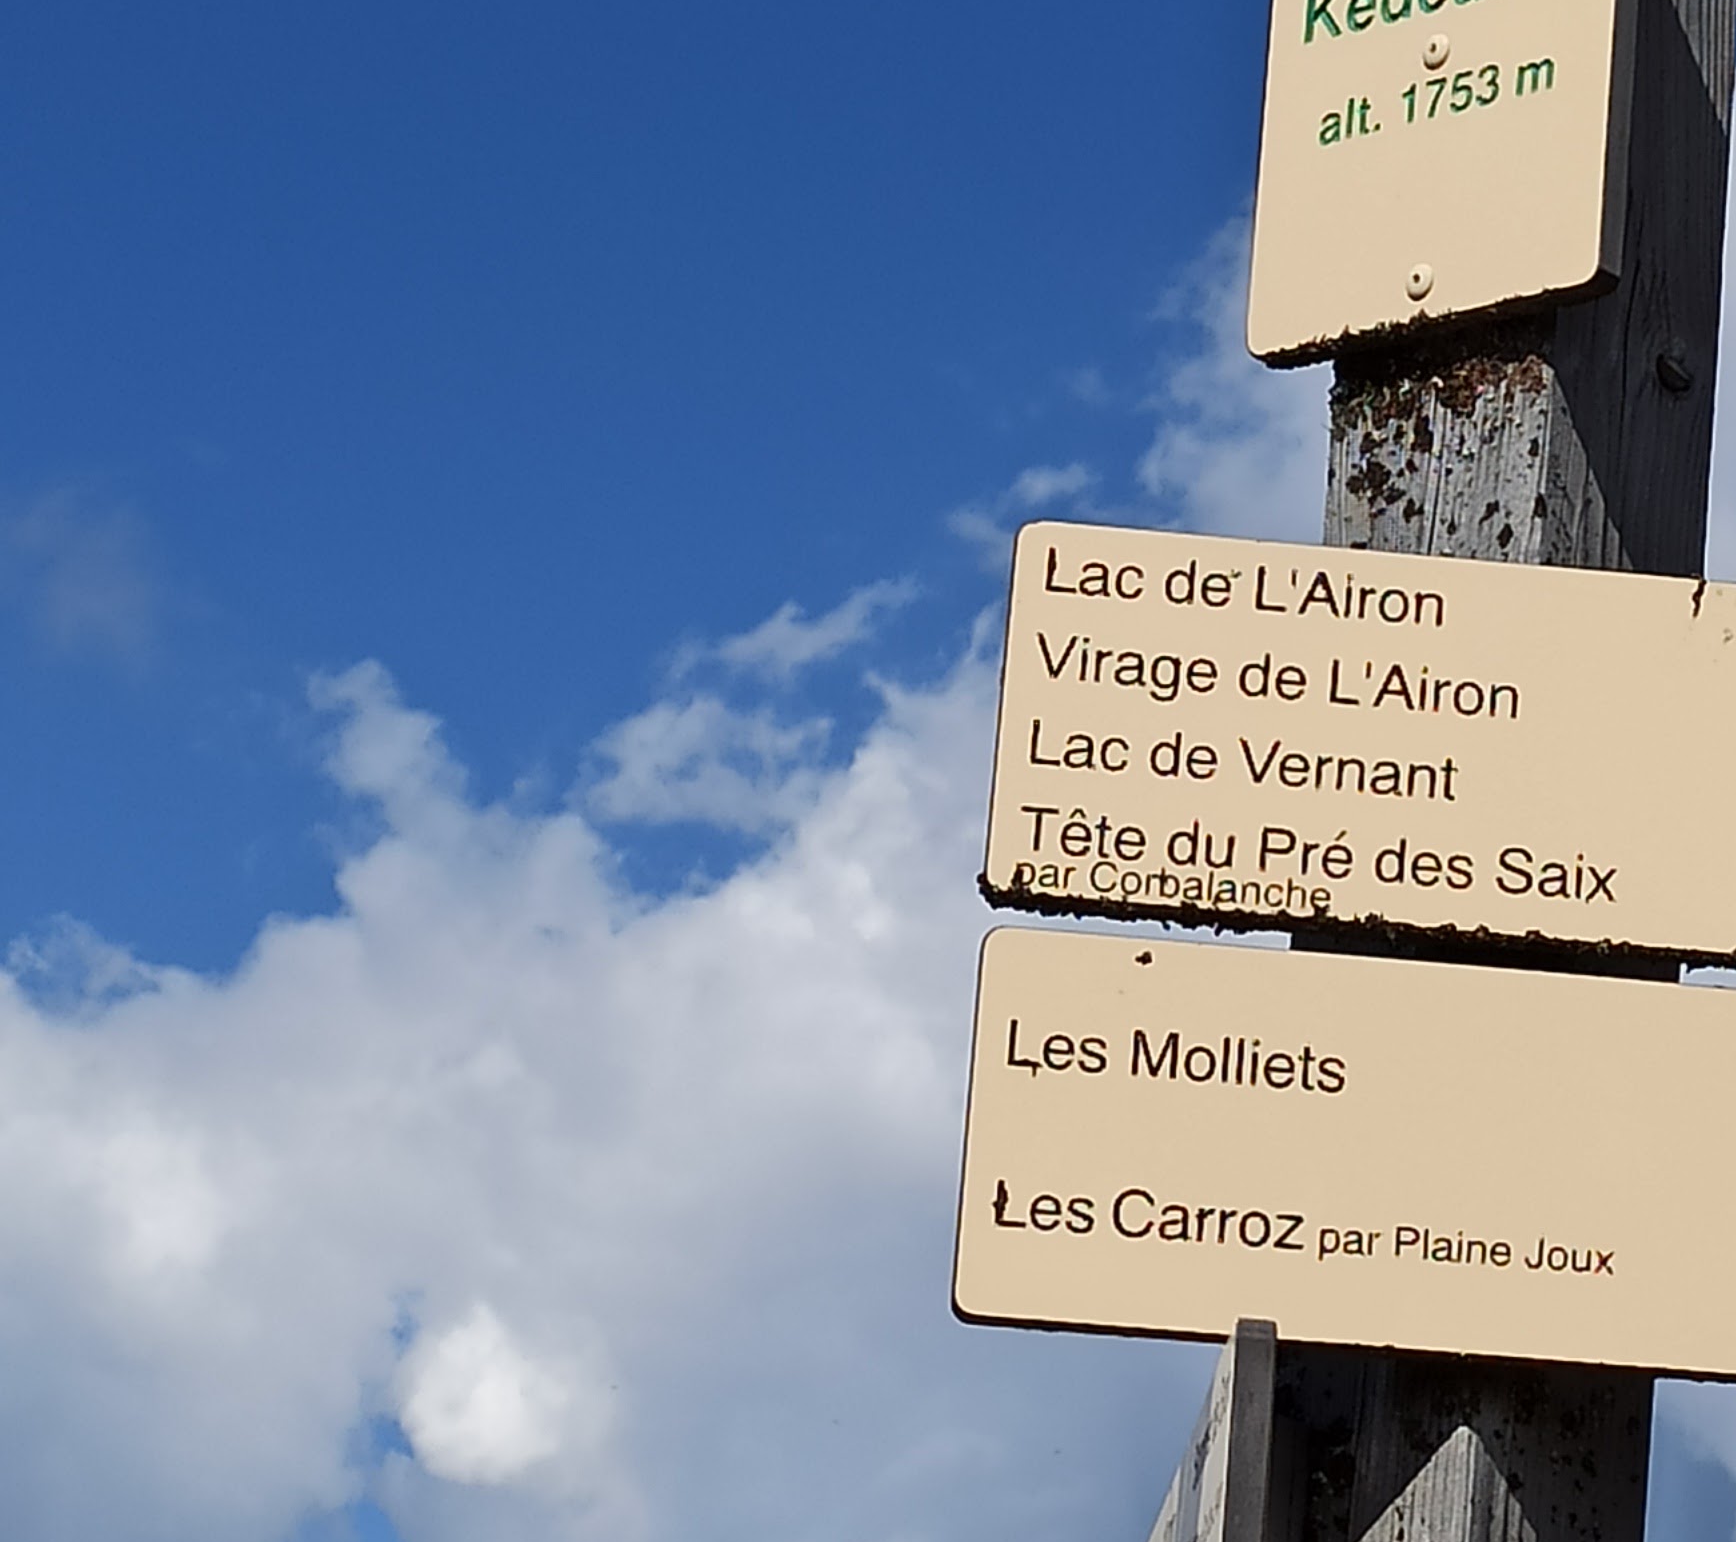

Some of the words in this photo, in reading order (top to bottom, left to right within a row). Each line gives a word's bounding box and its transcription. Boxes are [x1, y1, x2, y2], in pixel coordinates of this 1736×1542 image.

[1320, 98, 1380, 145] alt.
[1402, 63, 1500, 123] 1753
[1516, 59, 1554, 95] m
[1045, 547, 1144, 599] Lac
[1164, 559, 1233, 606] de
[1255, 565, 1445, 626] L'Airon
[1038, 633, 1217, 702] Virage
[1239, 653, 1306, 700] de
[1329, 659, 1520, 719] L'Airon
[1030, 719, 1129, 772] Lac
[1150, 732, 1217, 779] de
[1239, 738, 1458, 801] Vernant
[1012, 861, 1076, 889] par
[1089, 861, 1331, 909] Corbalanche
[1020, 805, 1147, 862] Tête
[1168, 820, 1235, 869] du
[1259, 827, 1353, 880] Pré
[1375, 838, 1473, 889] des
[1496, 848, 1617, 903] Saix
[1008, 1019, 1106, 1077] Les
[1131, 1030, 1345, 1093] Molliets
[992, 1180, 1094, 1233] Les
[1113, 1189, 1304, 1250] Carroz
[1318, 1226, 1381, 1261] par
[1395, 1227, 1511, 1266] Plaine
[1525, 1238, 1614, 1275] Joux
